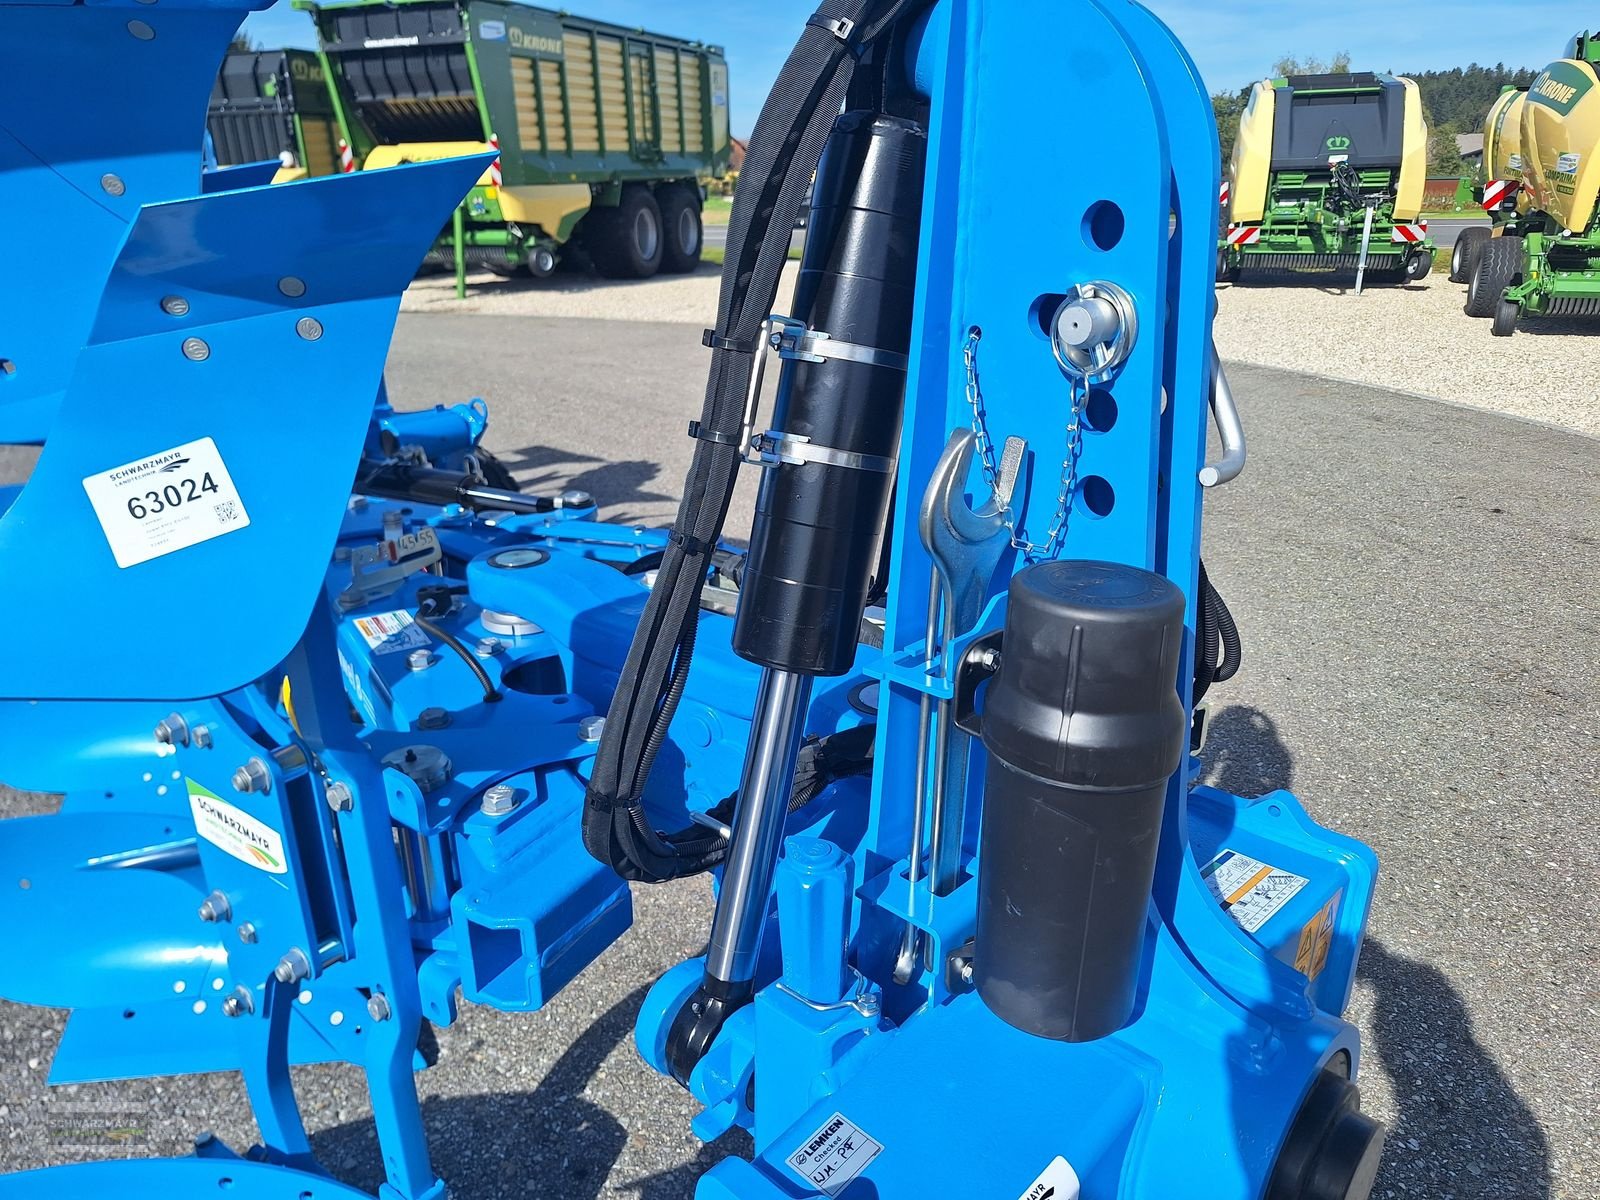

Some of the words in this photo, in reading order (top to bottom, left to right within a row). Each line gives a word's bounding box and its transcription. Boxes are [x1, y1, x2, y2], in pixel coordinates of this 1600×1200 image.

[523, 34, 562, 54] KRONE
[1543, 79, 1577, 104] KRONE
[109, 452, 182, 482] SCHWARZMAYR
[127, 471, 219, 520] 63024
[197, 797, 270, 851] SCHWARZMAYR
[803, 1118, 845, 1157] LEMKEN
[813, 1135, 843, 1163] Checked
